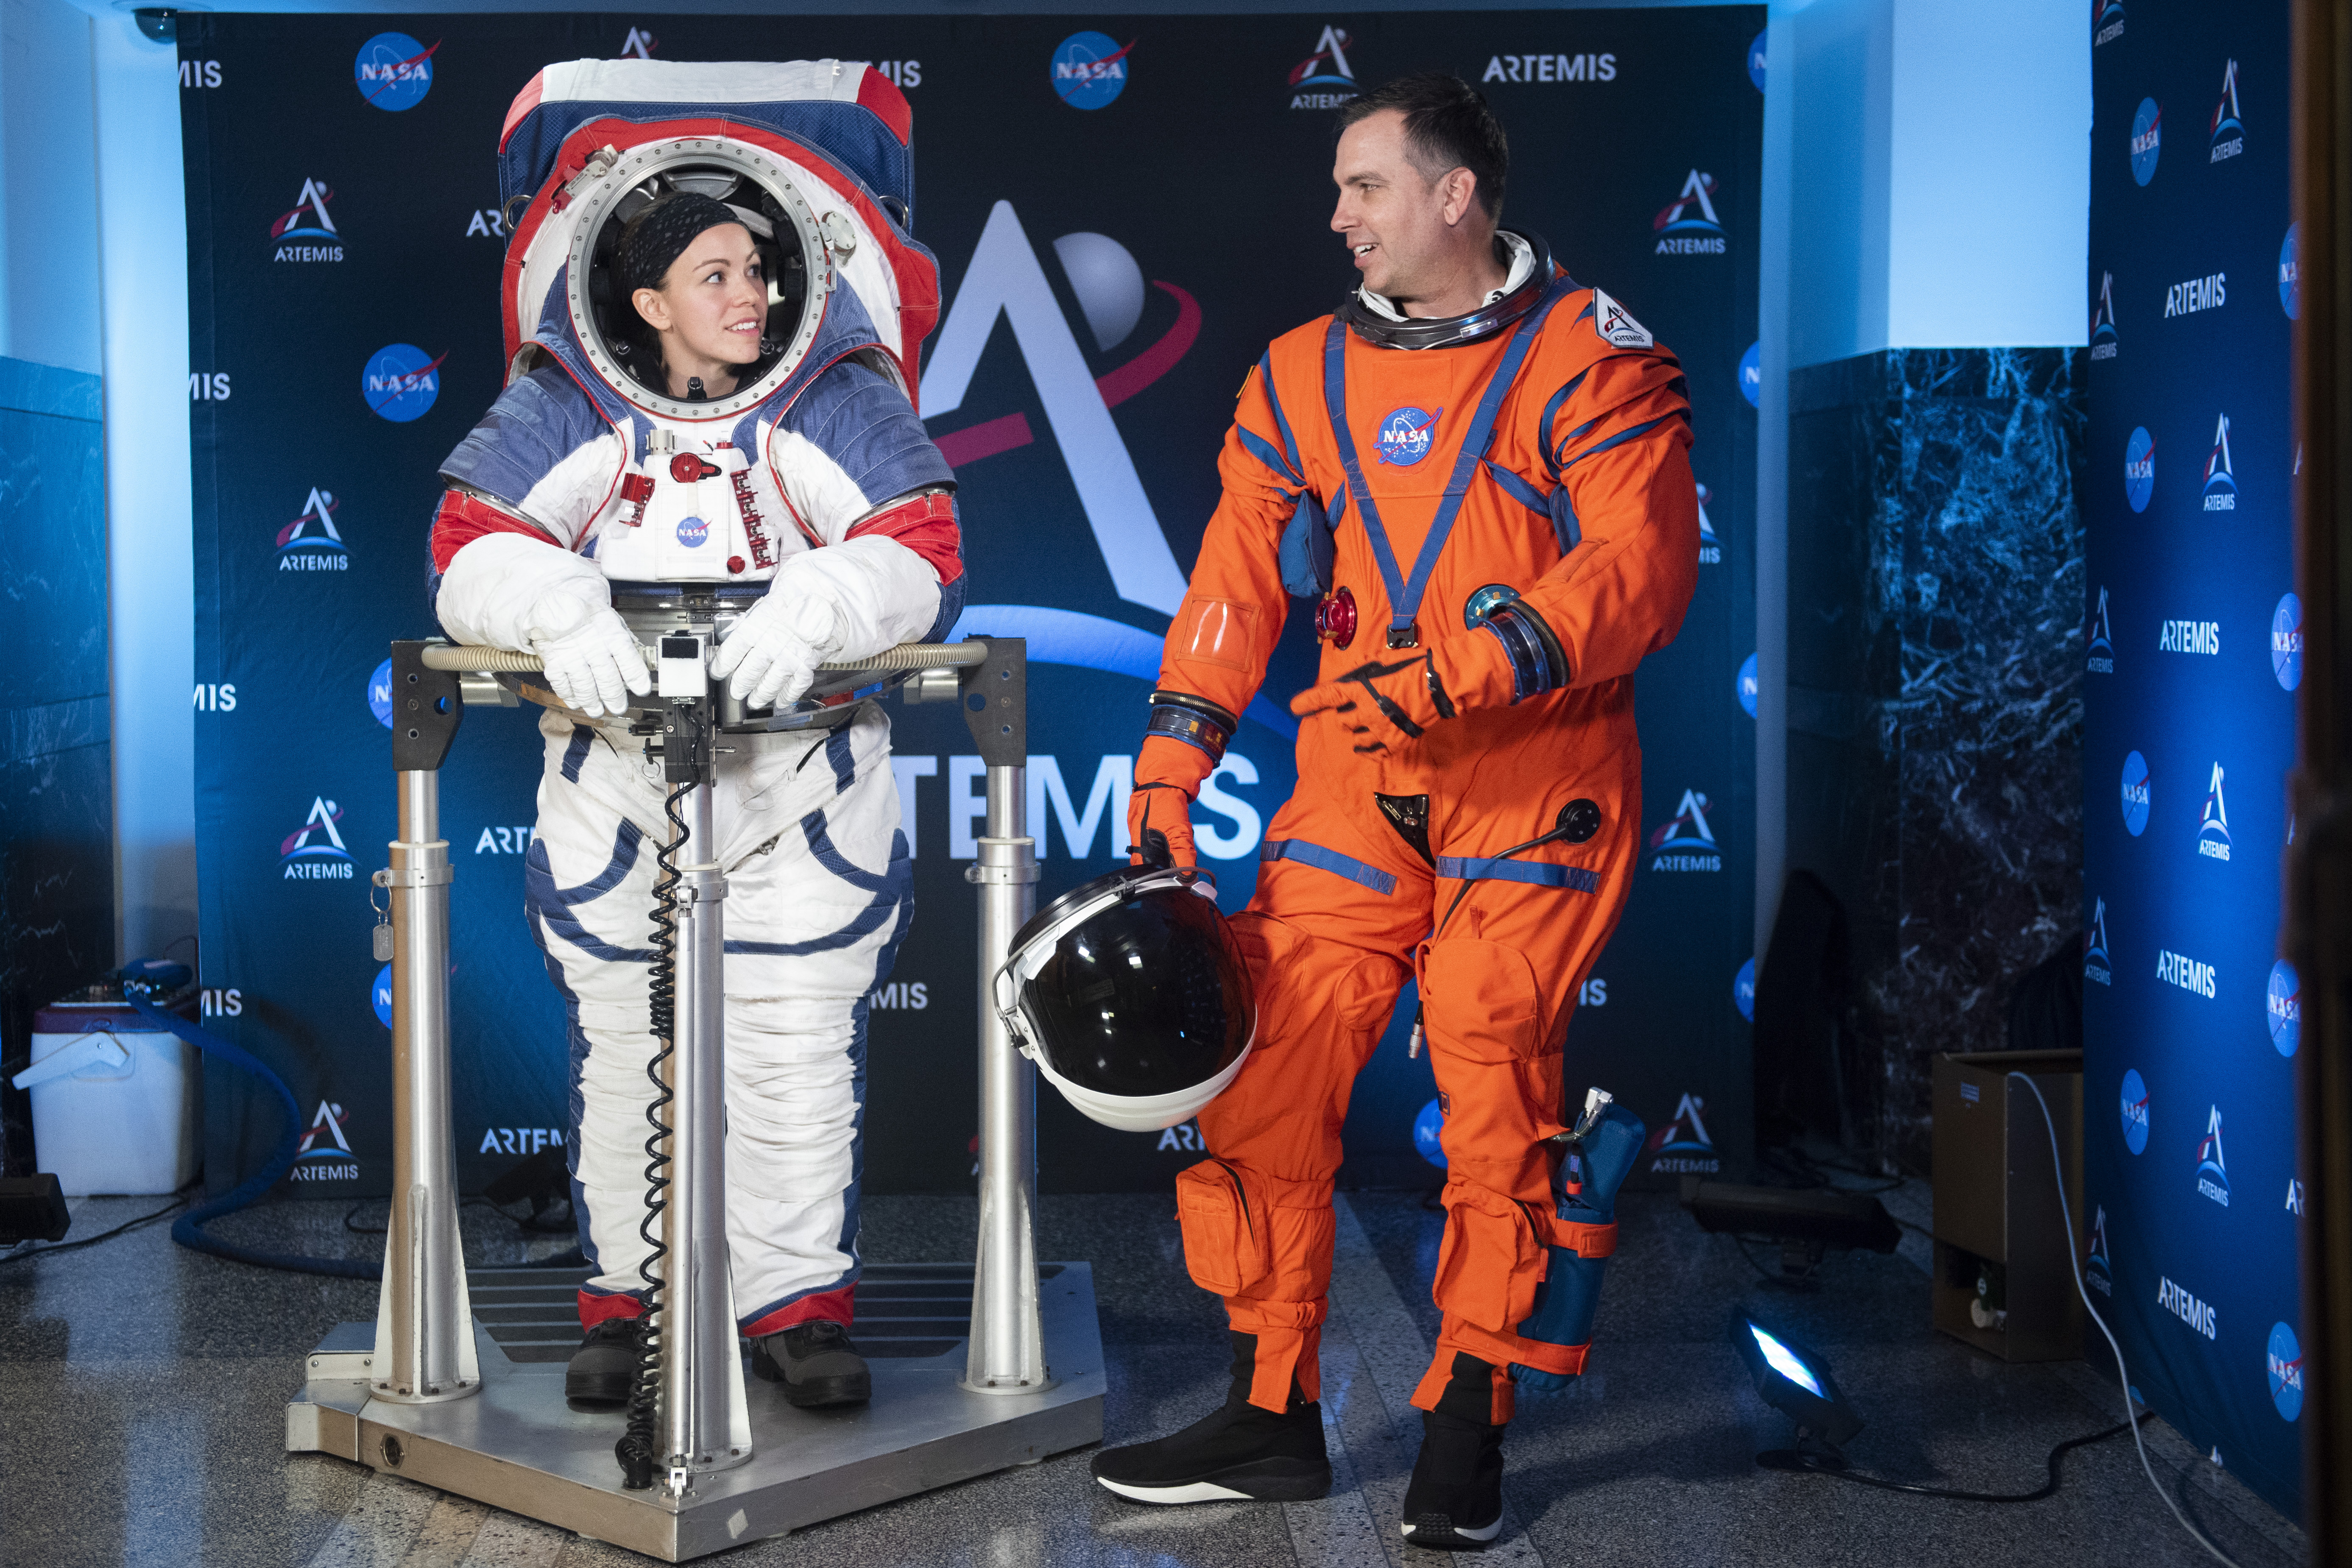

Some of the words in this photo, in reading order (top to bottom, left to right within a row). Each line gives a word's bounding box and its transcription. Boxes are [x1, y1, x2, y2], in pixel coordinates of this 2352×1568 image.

[2095, 19, 2124, 47] ARTEMIS
[362, 64, 429, 81] NASA
[1057, 62, 1124, 79] NASA
[1482, 53, 1616, 83] ARTEMIS
[1290, 93, 1359, 109] ARTEM
[2132, 130, 2159, 154] NASA
[2210, 137, 2242, 163] ARTEMIS
[274, 246, 343, 262] ARTEMIS
[1655, 238, 1726, 254] ARTEMIS
[2164, 273, 2225, 318] ARTEMIS
[1614, 335, 1645, 343] ARTEMIS
[2091, 342, 2117, 360] ARTEMIS
[369, 375, 435, 392] NASA
[1383, 430, 1428, 443] NASA
[2127, 461, 2153, 479] NASA
[2204, 494, 2235, 511] ARTEMIS
[279, 555, 348, 570] ARTEMIS
[2161, 621, 2219, 655] ARTEMIS
[2087, 657, 2113, 673] ARTEMIS
[2123, 784, 2148, 804] NASA
[891, 752, 1261, 860] TEMS
[475, 827, 534, 854] ART
[2199, 840, 2230, 861] ARTEMIS
[285, 863, 353, 879] ARTEMIS
[1652, 855, 1721, 871] ARTEMIS
[2085, 965, 2111, 986] ARTEMIS
[2157, 951, 2215, 999] ARTEMIS
[2122, 1099, 2147, 1126] NASA
[291, 1164, 359, 1181] ARTEMIS
[1651, 1158, 1719, 1173] ARTEMIS
[2198, 1178, 2228, 1207] ARTEMIS
[2157, 1276, 2215, 1339] ARTEMIS
[2268, 1353, 2302, 1390] NASA
